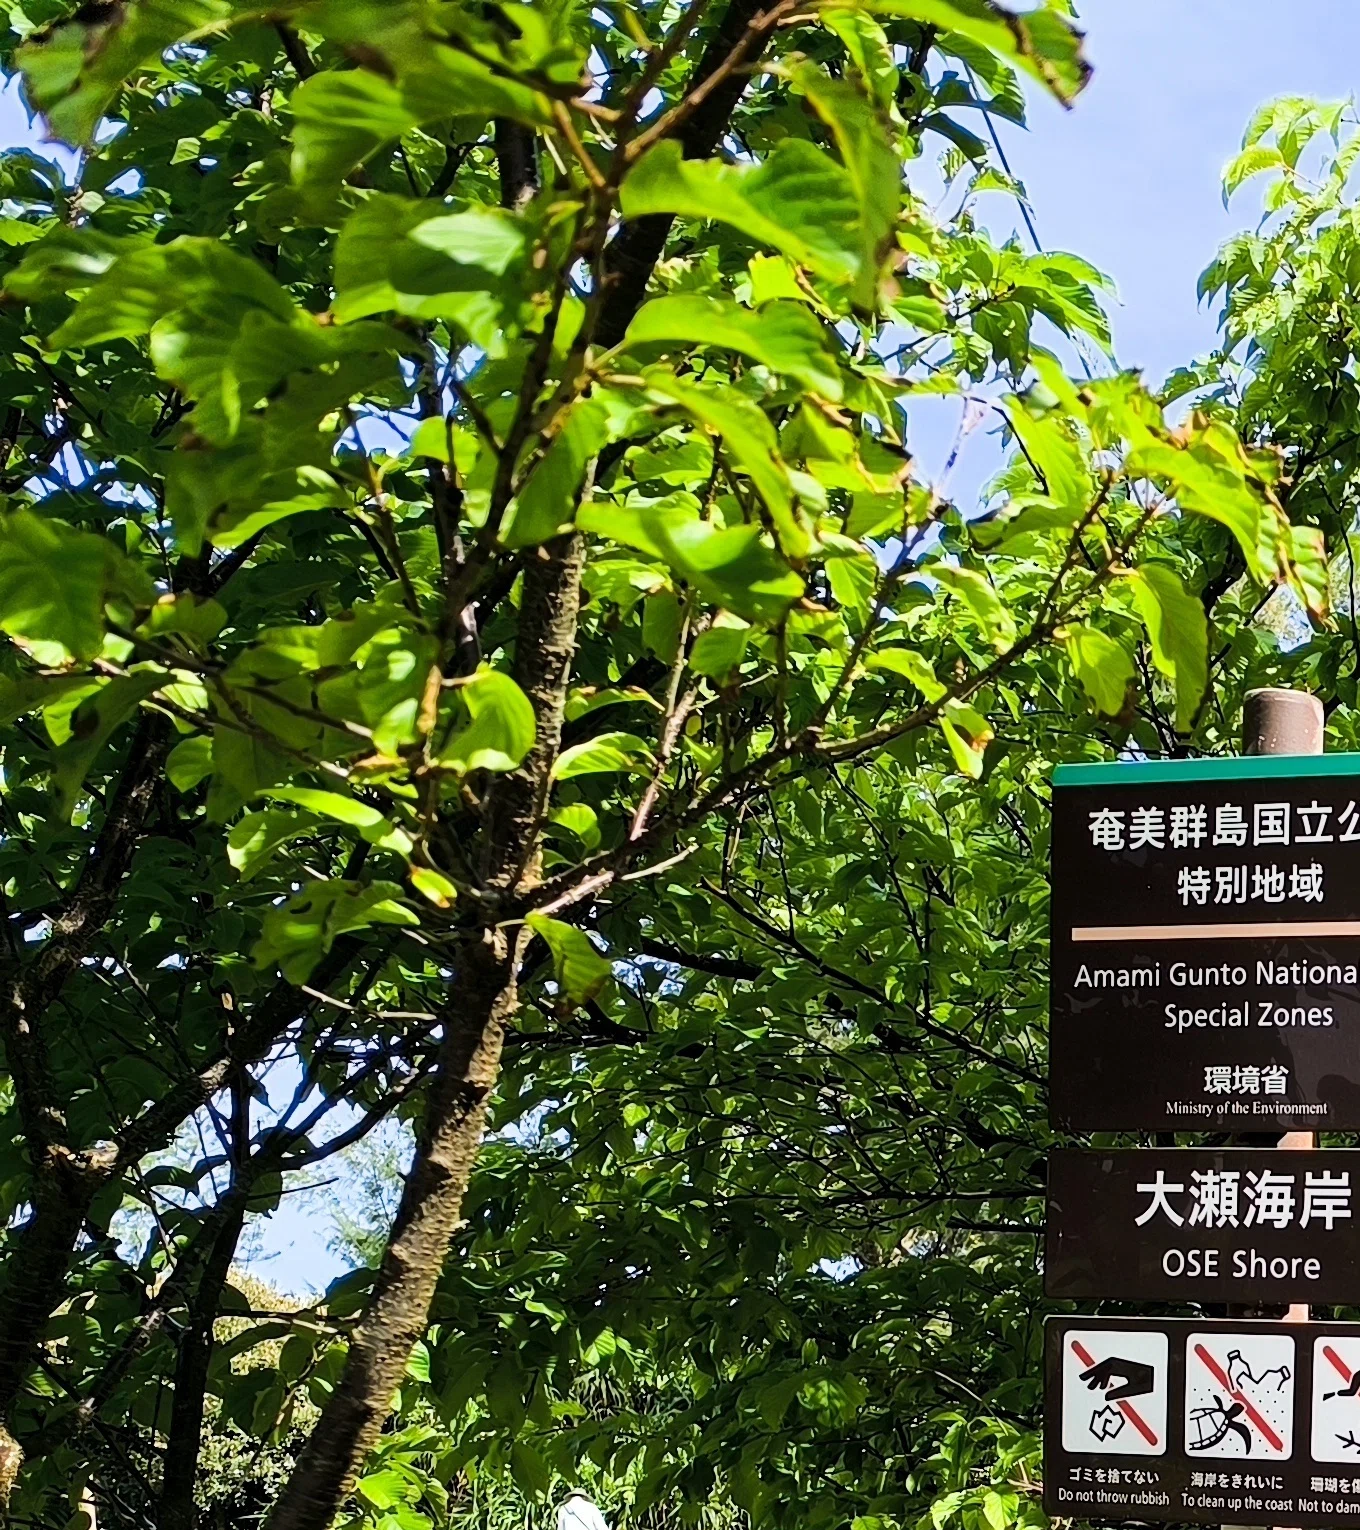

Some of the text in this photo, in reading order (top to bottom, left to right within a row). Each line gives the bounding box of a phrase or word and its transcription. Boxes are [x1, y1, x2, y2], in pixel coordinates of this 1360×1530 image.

[1177, 863, 1324, 905] 特別地域
[1074, 963, 1161, 988] Amami
[1169, 962, 1247, 987] Gunto
[1165, 1002, 1334, 1033] Special Zones
[1203, 1065, 1289, 1095] 環境省
[1166, 1101, 1328, 1117] Ministry of the Environment
[1134, 1169, 1352, 1230] 大瀬海岸
[1162, 1249, 1321, 1280] OSE Shore
[1069, 1466, 1160, 1485] ゴミを捨てない
[1190, 1471, 1283, 1490] 海岸をきれいに
[1058, 1488, 1170, 1506] Do not throw rubbish
[1181, 1493, 1293, 1512] To clean up the coast
[1298, 1498, 1318, 1514] Not
[1321, 1500, 1334, 1514] to
